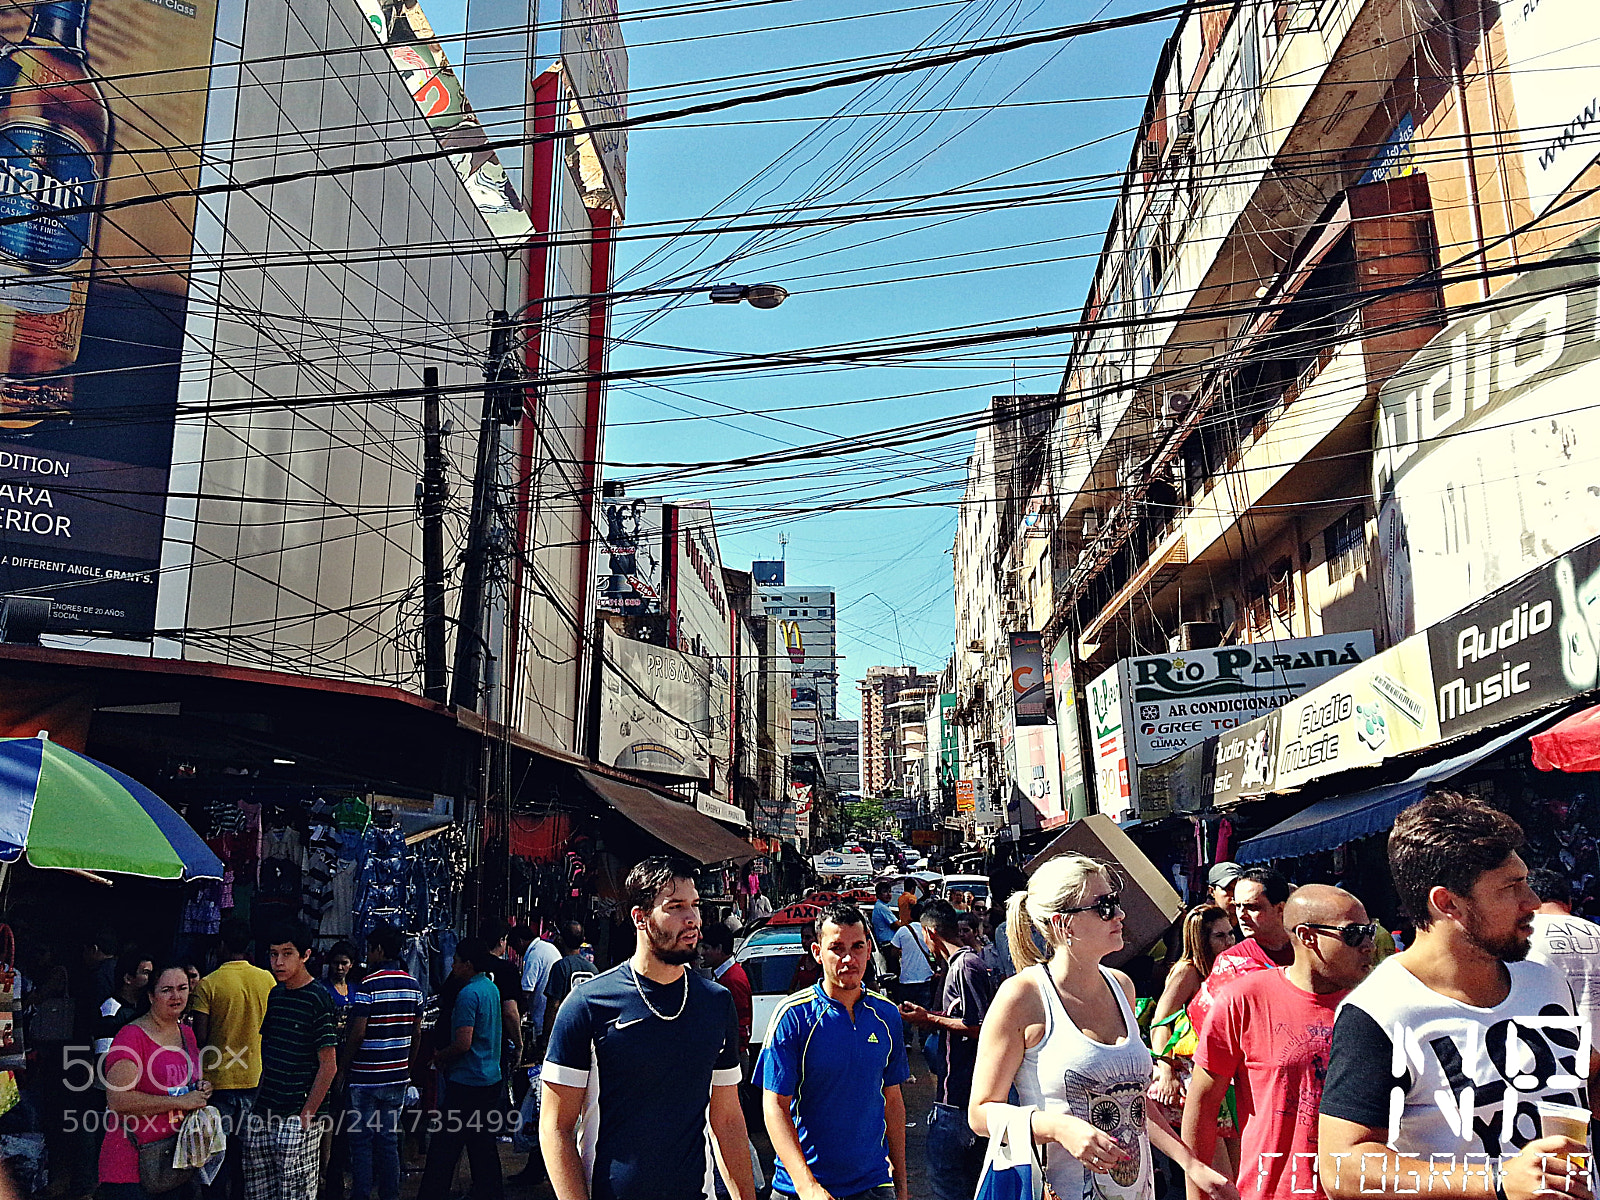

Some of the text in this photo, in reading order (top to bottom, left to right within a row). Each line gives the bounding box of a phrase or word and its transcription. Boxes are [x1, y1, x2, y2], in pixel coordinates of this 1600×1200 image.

[165, 0, 194, 16] Class
[12, 557, 66, 572] DIFFERENT
[67, 564, 104, 578] ANGLE.
[53, 611, 79, 620] SOCIAL
[83, 606, 93, 614] DE
[95, 607, 103, 615] 20
[104, 608, 125, 617] AÑOS
[1457, 599, 1553, 670] Audio
[1439, 660, 1531, 724] Music
[1168, 704, 1188, 717] AR
[1298, 693, 1352, 738] Audio
[1157, 721, 1202, 734] GREE
[1150, 738, 1187, 748] CLIMAX
[1280, 732, 1340, 776] Music
[784, 906, 817, 919] TAXI
